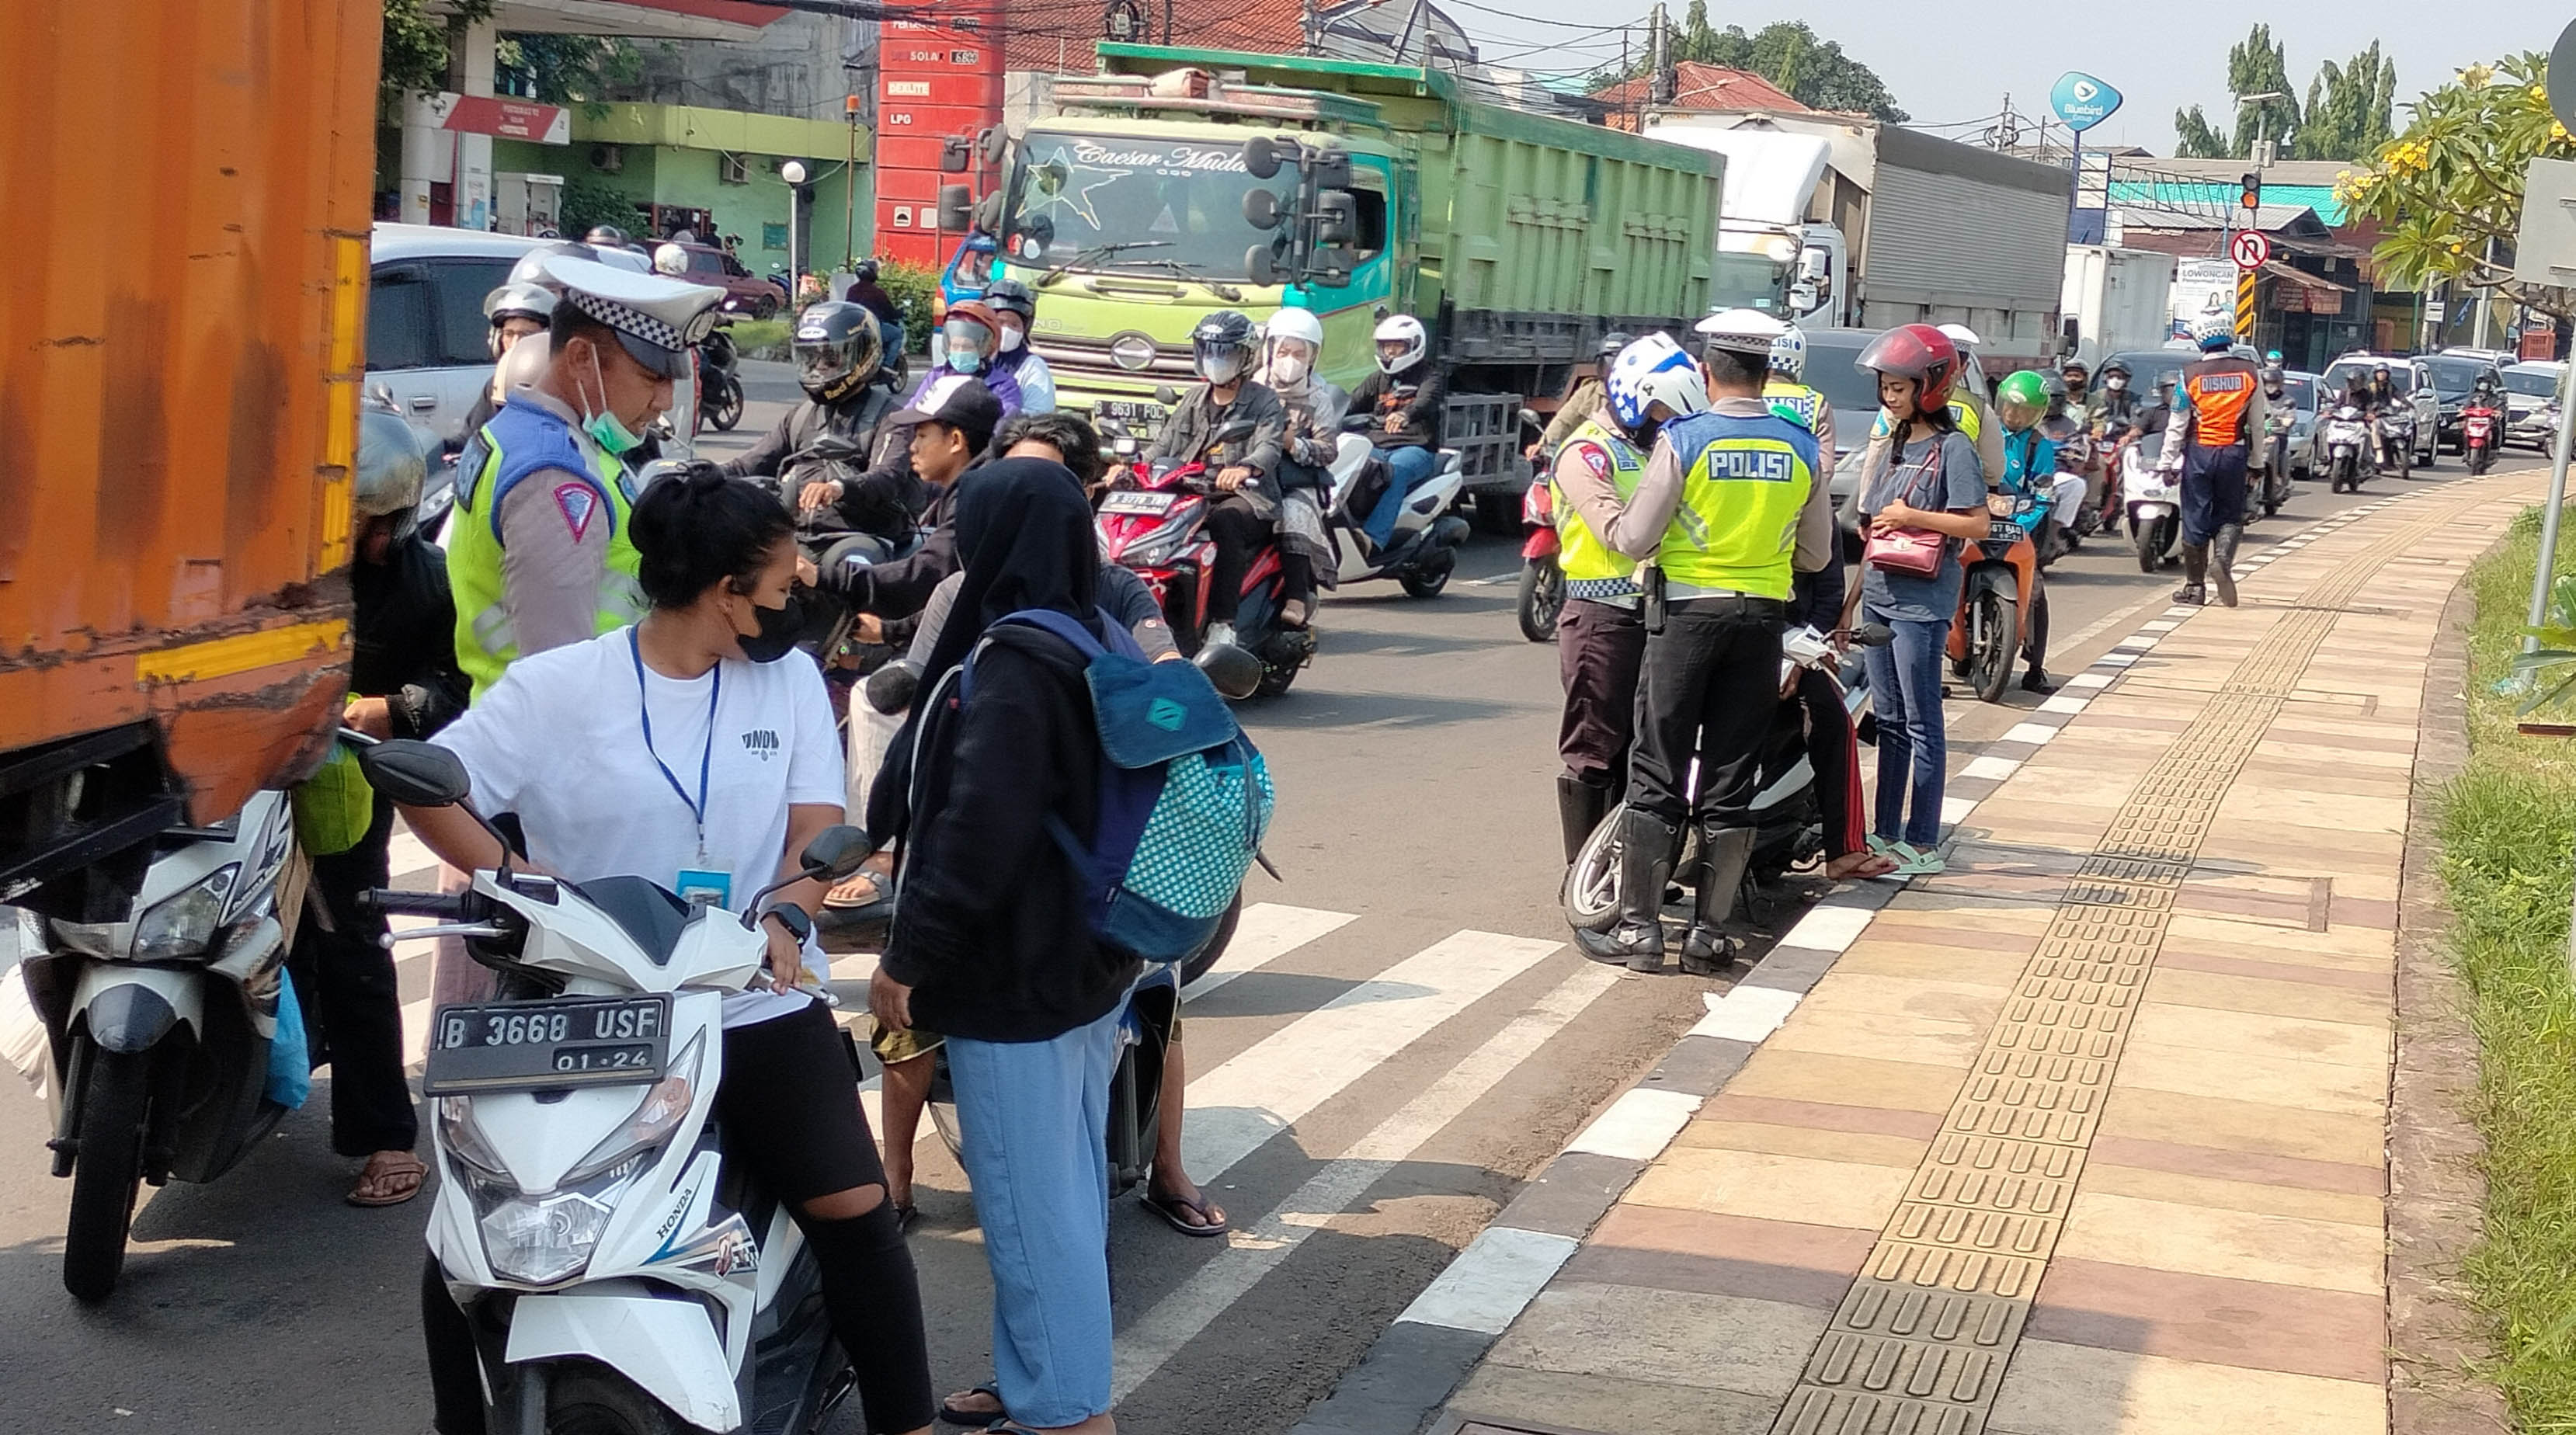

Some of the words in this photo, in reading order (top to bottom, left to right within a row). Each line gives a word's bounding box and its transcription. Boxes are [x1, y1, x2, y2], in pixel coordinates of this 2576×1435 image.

[890, 113, 912, 124] LPG
[2064, 103, 2103, 116] Bluebird
[1073, 141, 1161, 165] Caesar
[1163, 147, 1248, 172] Muda
[2202, 376, 2242, 392] DISHUB
[1095, 401, 1103, 415] B
[1111, 402, 1137, 417] 9631
[1710, 452, 1791, 479] POLISI
[445, 1018, 465, 1048] B
[485, 1013, 567, 1046] 3668
[595, 1008, 655, 1039] USF
[655, 1188, 693, 1241] HONDA
